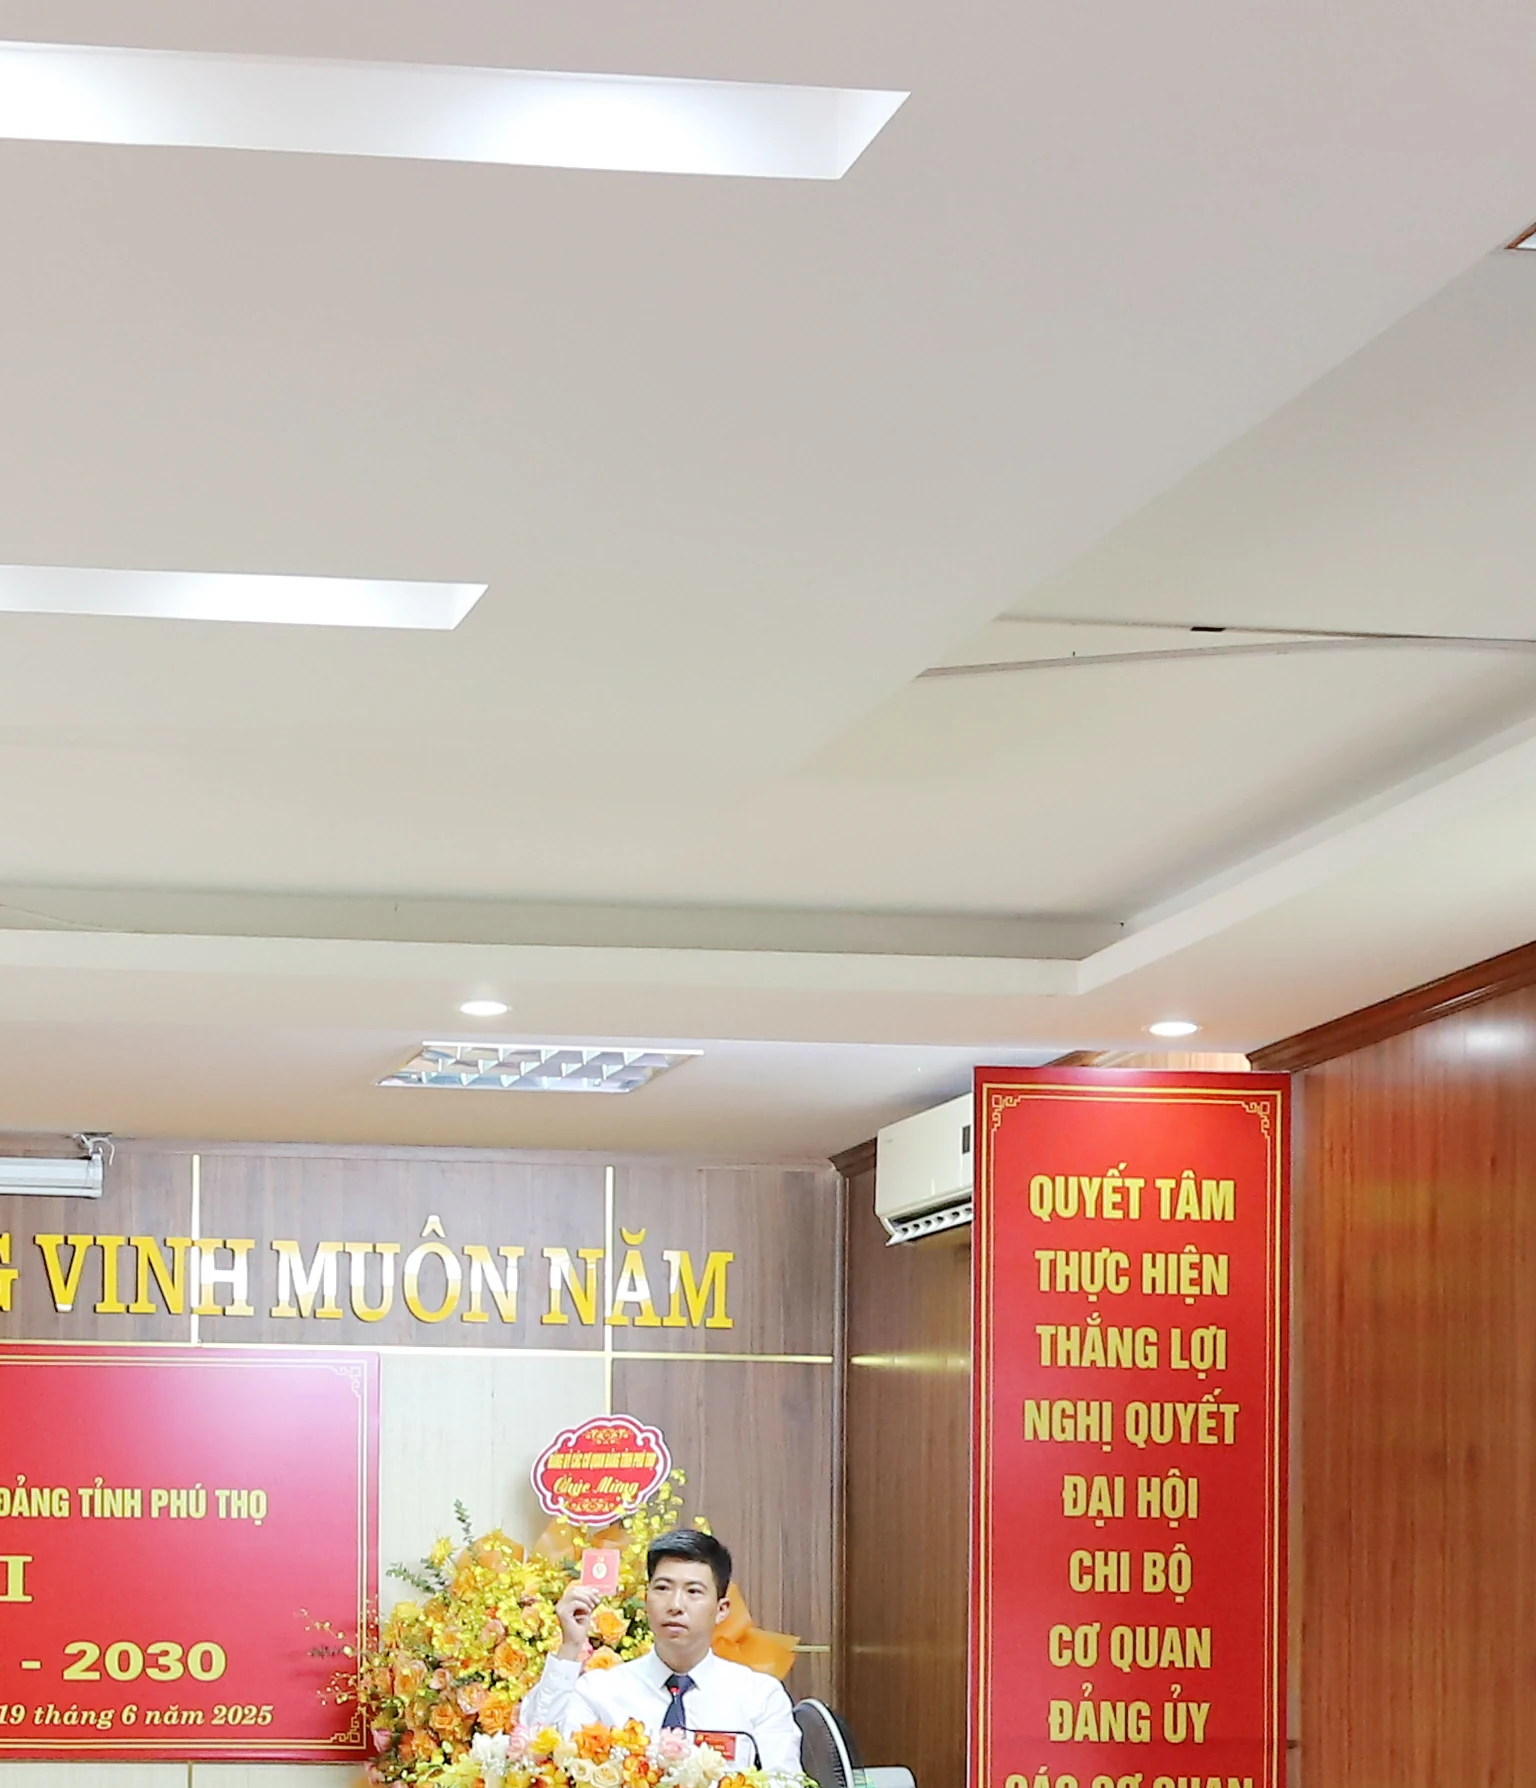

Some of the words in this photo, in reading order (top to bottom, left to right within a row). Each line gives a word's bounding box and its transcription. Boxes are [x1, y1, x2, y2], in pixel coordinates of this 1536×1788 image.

[1029, 1162, 1145, 1222] QUYẾT
[1155, 1169, 1235, 1221] TÂM
[34, 1234, 256, 1317] VINH
[269, 1214, 525, 1323] MUÔN
[541, 1226, 735, 1329] NĂM
[1034, 1247, 1130, 1302] THỰC
[1142, 1244, 1229, 1305] HIỆN
[1035, 1312, 1158, 1369] THẮNG
[1170, 1325, 1227, 1380] LỢI
[1024, 1399, 1112, 1452] NGHỊ
[1125, 1387, 1240, 1449] QUYẾT
[77, 1476, 142, 1518] TỈNH
[151, 1483, 206, 1518] PHÚ
[215, 1489, 269, 1526] THỌ
[1061, 1475, 1125, 1527] ĐẠI
[1137, 1468, 1198, 1528] HỘI
[1069, 1549, 1130, 1593] CHI
[1143, 1543, 1192, 1604] BỘ
[21, 1660, 41, 1669] -
[63, 1641, 226, 1681] 2030
[1049, 1622, 1101, 1668] CƠ
[1110, 1625, 1211, 1672] QUAN
[34, 1703, 115, 1730] tháng
[121, 1704, 138, 1725] 6
[144, 1704, 205, 1725] năm
[211, 1704, 274, 1726] 2025
[1047, 1682, 1151, 1743] ĐẢNG
[1163, 1683, 1211, 1744] ỦY
